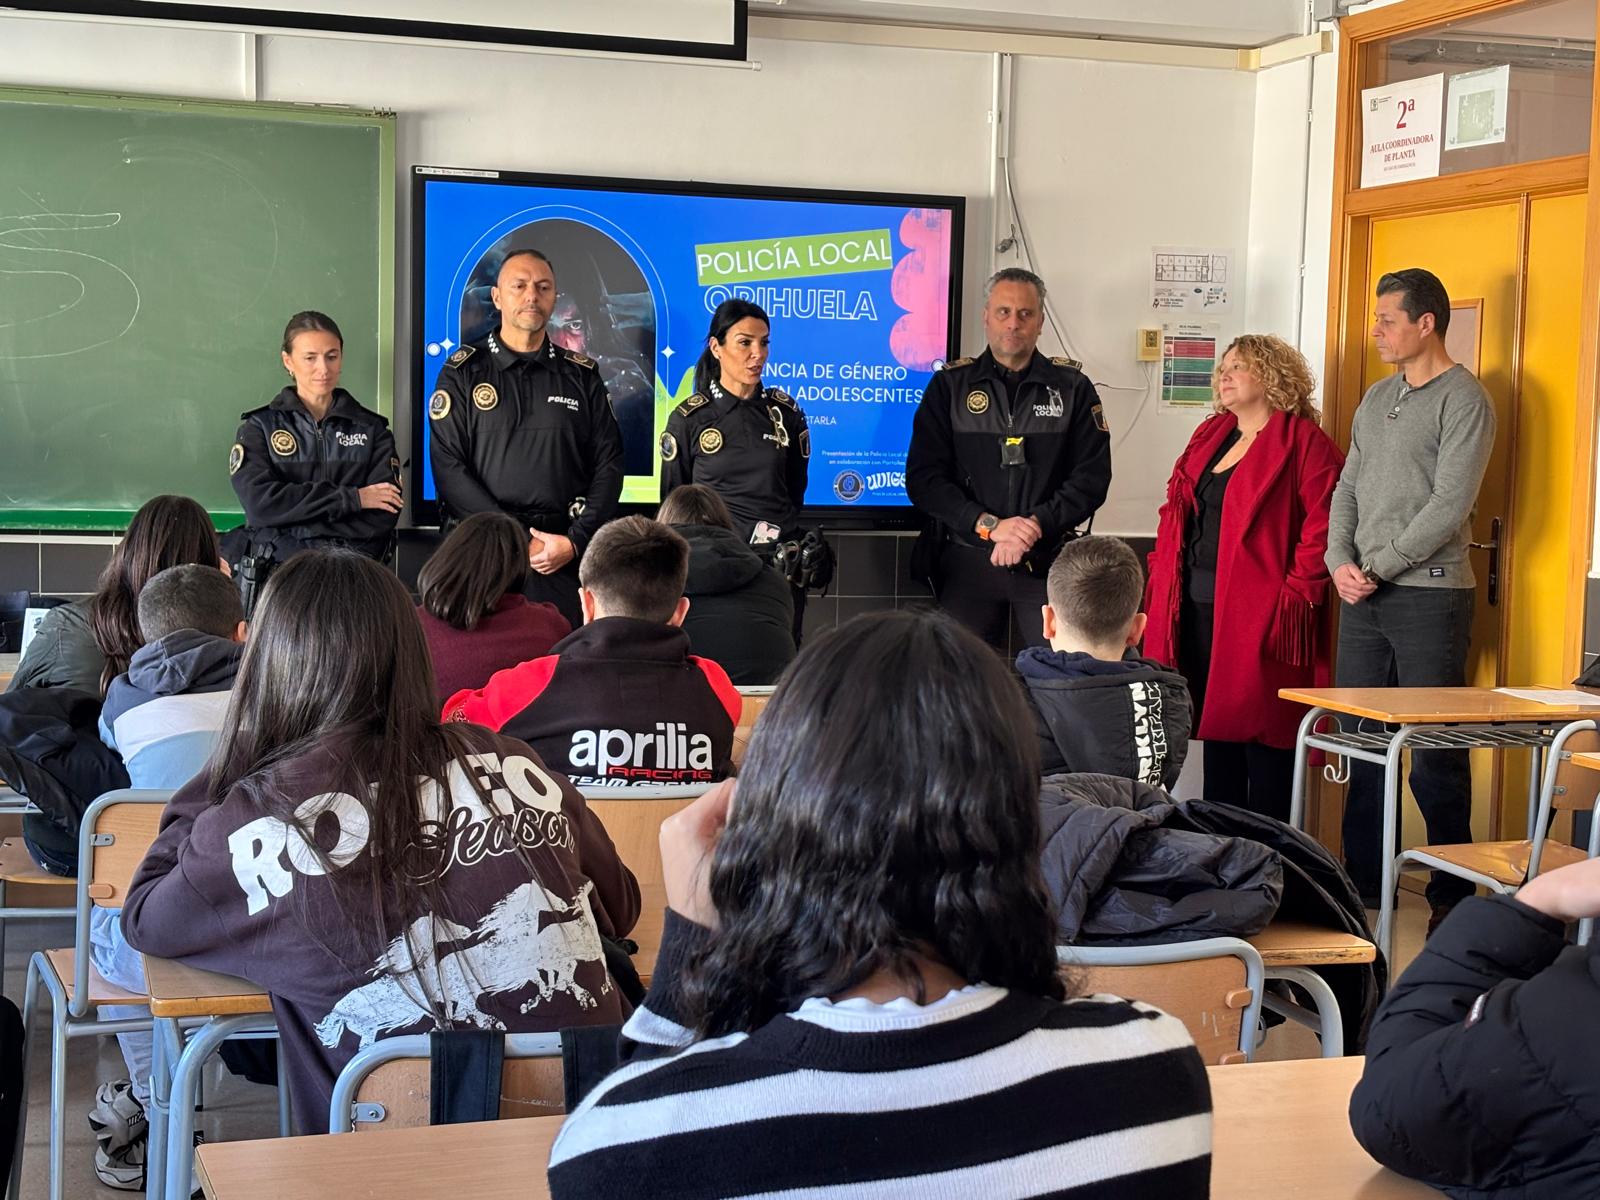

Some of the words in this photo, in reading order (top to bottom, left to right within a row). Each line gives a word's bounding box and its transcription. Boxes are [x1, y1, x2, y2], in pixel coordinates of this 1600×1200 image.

[1370, 142, 1385, 154] AULA
[1385, 134, 1434, 150] COORDINADORA
[1384, 154, 1391, 162] DE
[1391, 149, 1416, 161] PLANTA
[697, 242, 800, 277] POLICÍA
[808, 238, 893, 267] LOCAL
[761, 362, 808, 378] NCIA
[813, 364, 834, 379] DE
[839, 361, 908, 381] GÉNERO
[547, 396, 579, 406] POLICIA
[796, 386, 923, 404] ADOLESCENTES
[339, 438, 365, 446] LOCAL
[568, 722, 713, 776] aprilia
[608, 766, 712, 780] RACING
